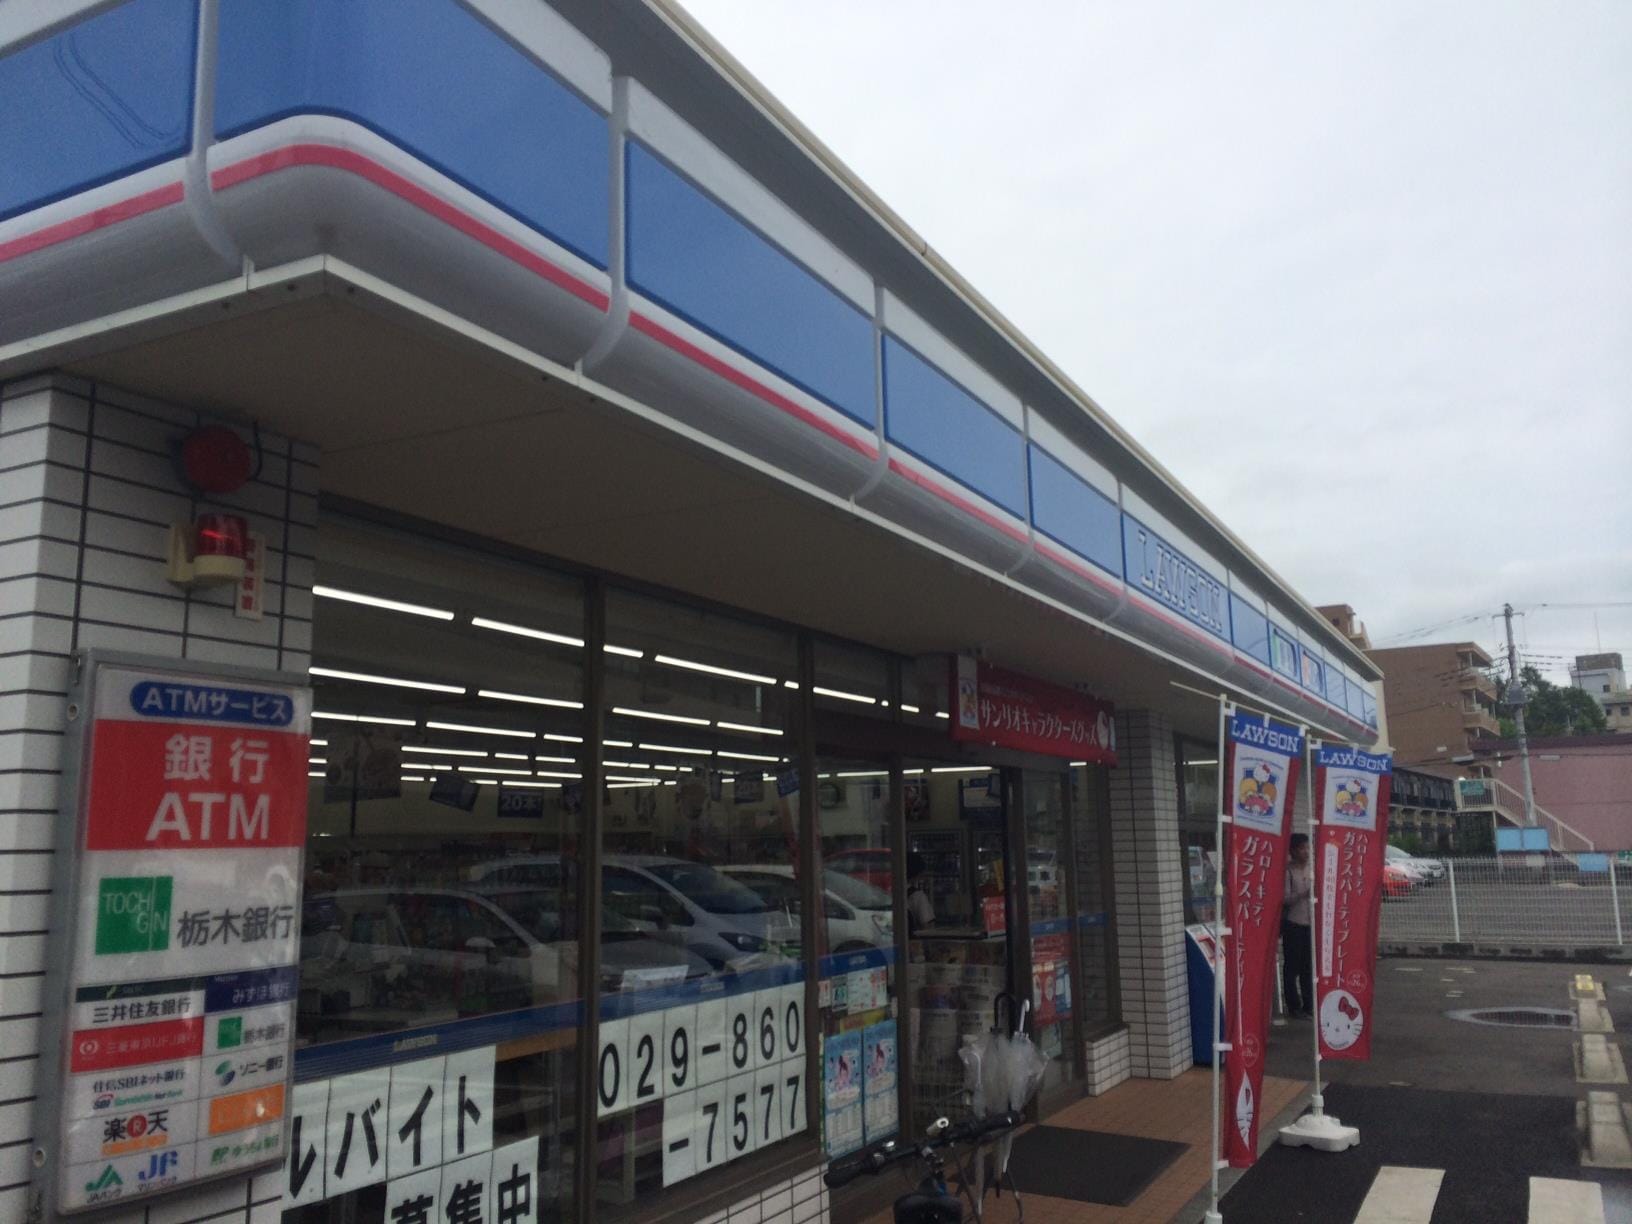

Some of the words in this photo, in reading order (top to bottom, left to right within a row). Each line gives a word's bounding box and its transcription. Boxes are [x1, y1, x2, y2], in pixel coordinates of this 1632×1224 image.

[1138, 529, 1223, 633] LAWSON
[142, 687, 288, 721] ATMサービス
[163, 733, 270, 784] 銀行
[1231, 719, 1300, 754] LAWSON
[1319, 750, 1389, 772] LAWSON
[145, 792, 271, 841] ATM
[1252, 840, 1273, 928] ハローキティ
[1355, 833, 1369, 897] ハローキティ
[177, 904, 294, 949] 栃木銀行
[93, 996, 191, 1024] 三井住友銀行
[239, 1055, 284, 1077] ソニー銀行
[600, 999, 800, 1109] 029-860
[93, 1067, 185, 1094] 住信SBIネット銀行
[668, 1075, 800, 1165] -7577
